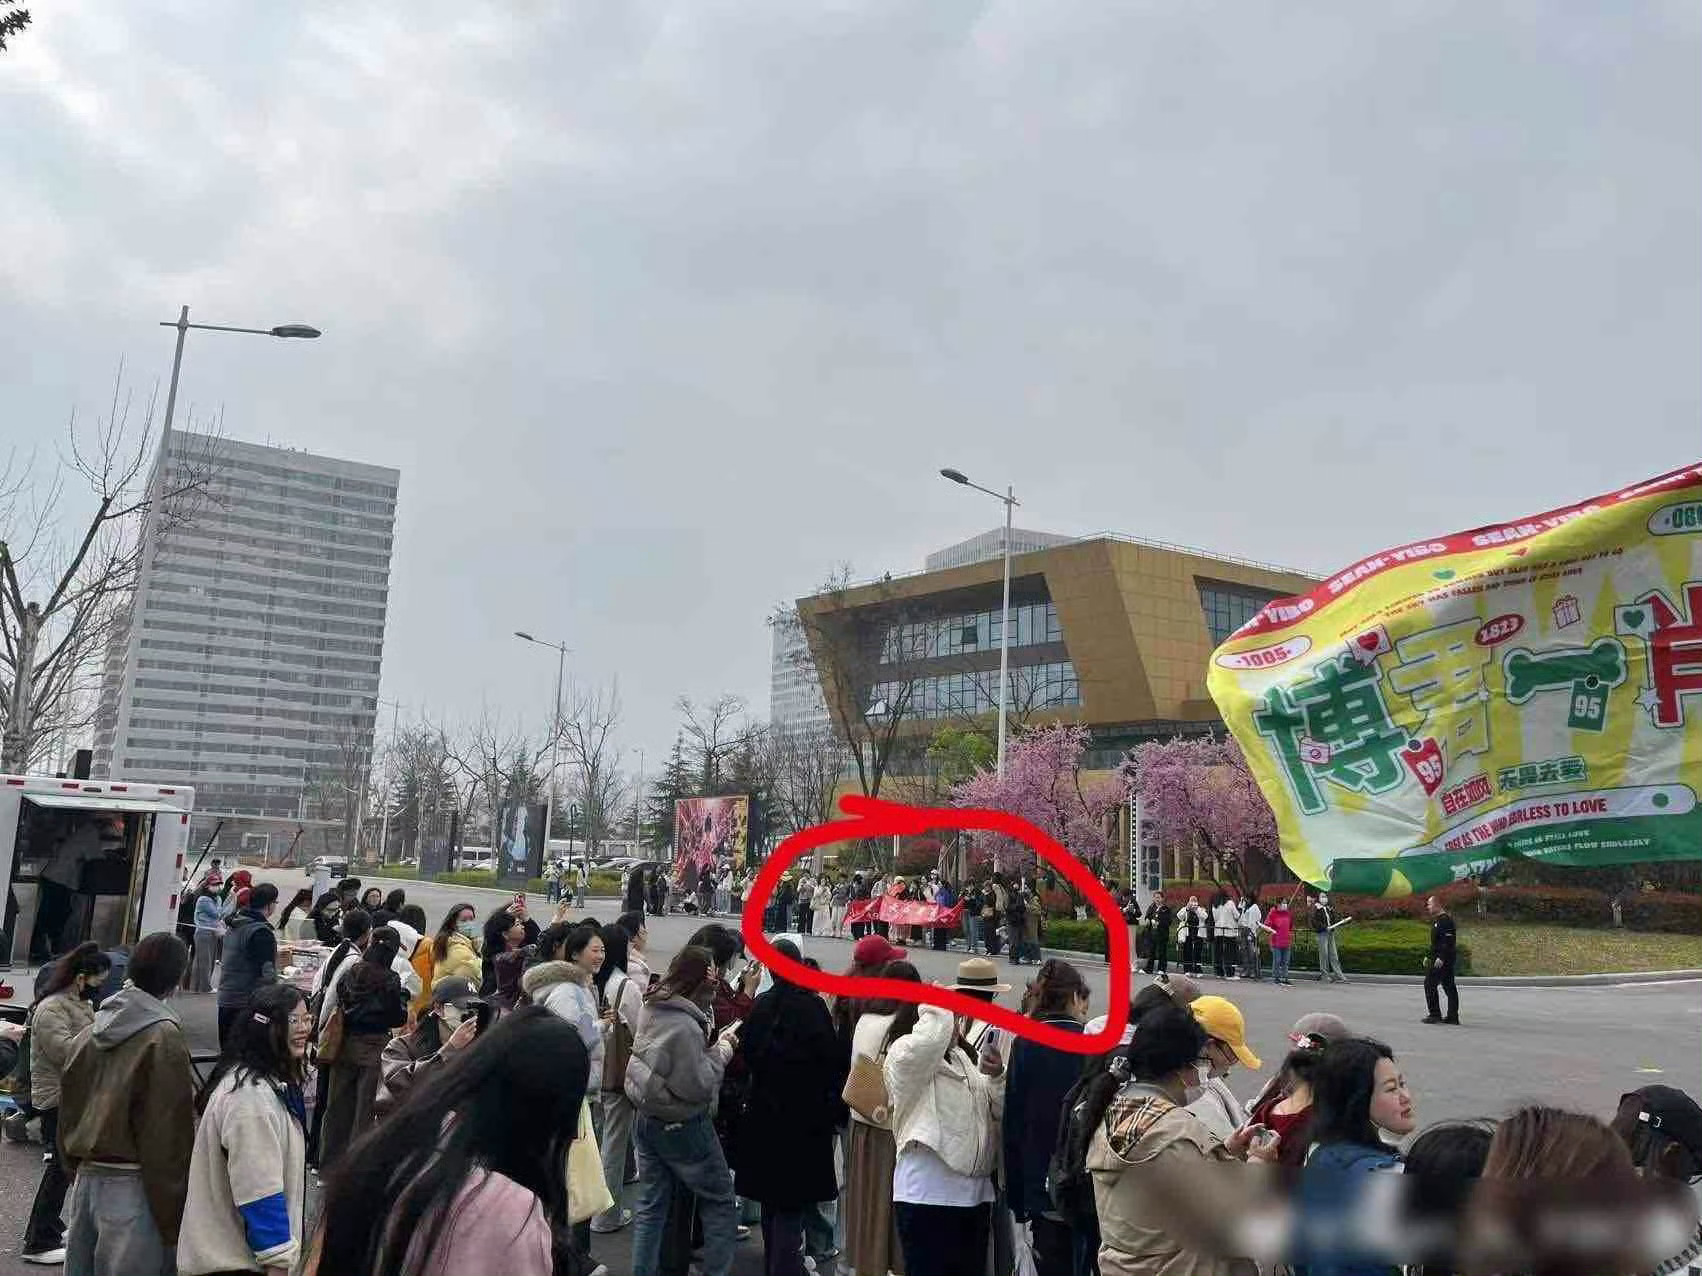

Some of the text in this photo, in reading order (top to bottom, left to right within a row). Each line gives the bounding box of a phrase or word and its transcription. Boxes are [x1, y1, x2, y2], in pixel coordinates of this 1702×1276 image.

[1479, 616, 1519, 643] 1823
[1573, 694, 1602, 717] 95
[1415, 757, 1442, 784] 95
[1472, 825, 1493, 842] THE
[1554, 802, 1571, 817] TO
[1573, 797, 1608, 814] LOVE
